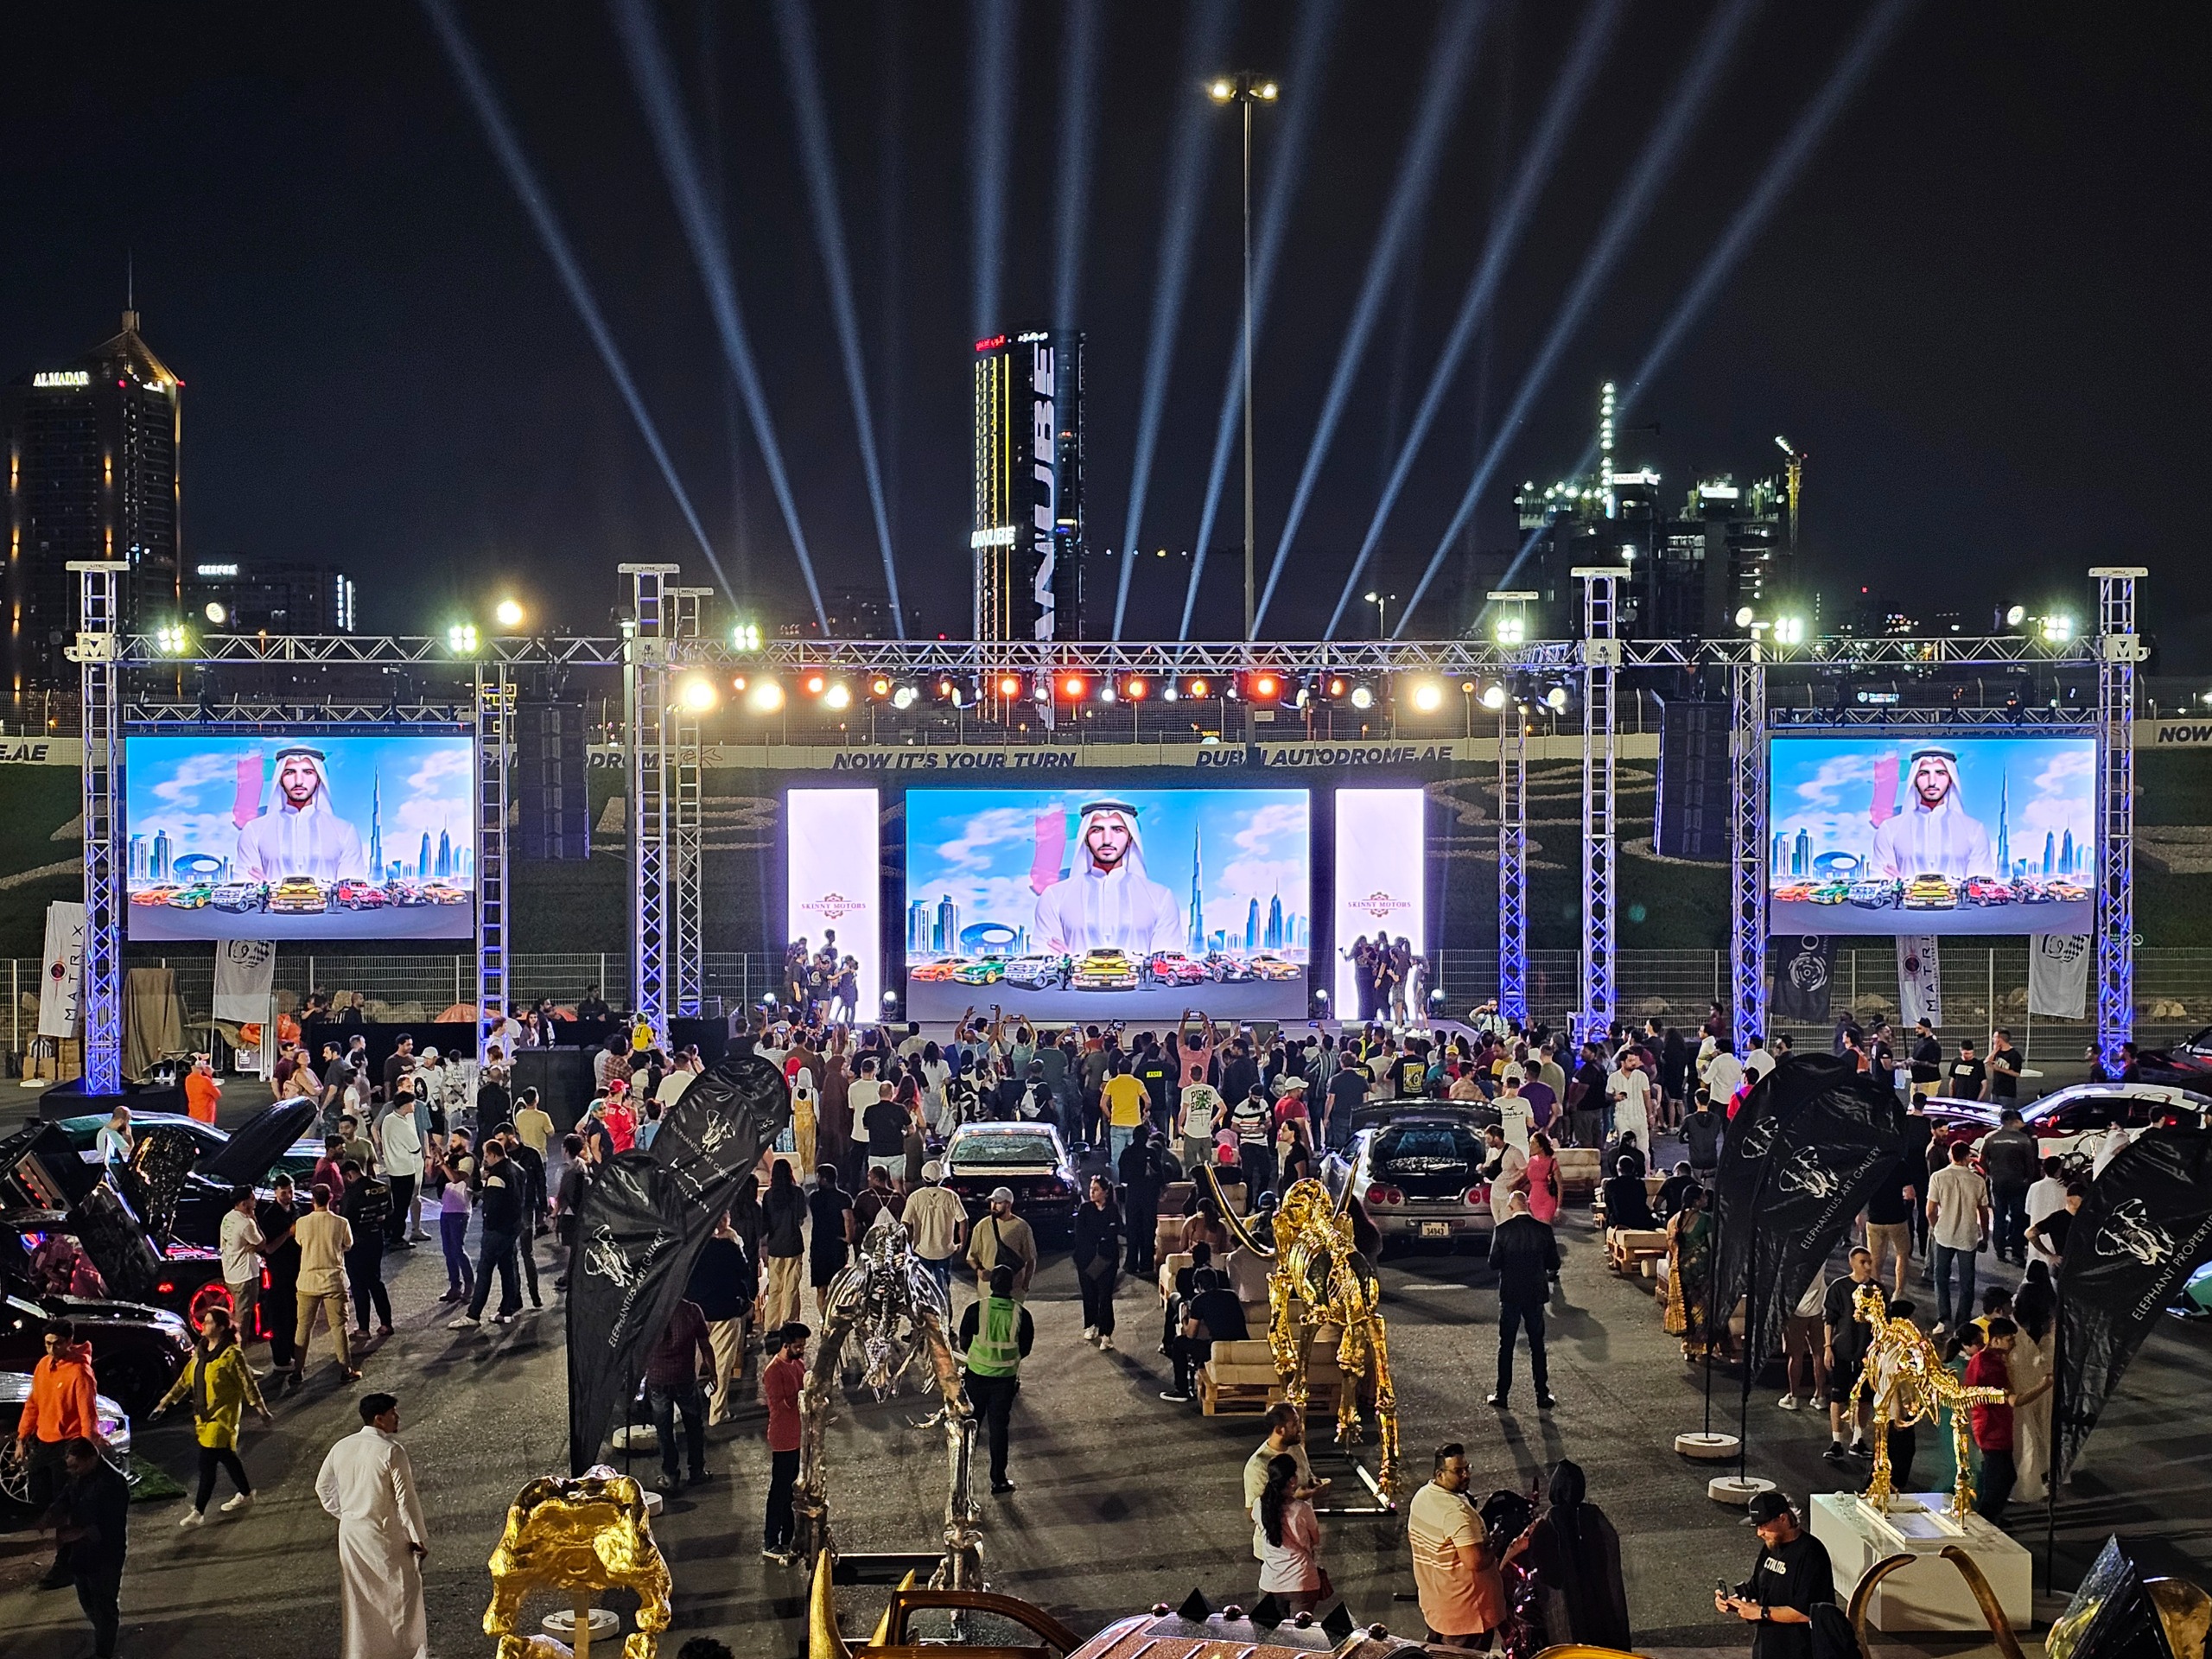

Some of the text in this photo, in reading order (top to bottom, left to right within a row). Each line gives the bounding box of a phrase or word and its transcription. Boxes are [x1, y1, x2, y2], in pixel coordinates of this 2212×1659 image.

[971, 525, 1016, 549] DANUBE
[2158, 726, 2212, 742] NOW
[831, 753, 1077, 769] NOW IT'S YOUR TURN
[1196, 747, 1453, 766] DUBI AUTODROME.AE
[65, 924, 85, 1021] MATRIX
[702, 1154, 714, 1165] ART
[1801, 1146, 1883, 1250] ELEPHANTUS ART GALLERY
[2132, 1267, 2177, 1321] ELEPHANT
[608, 1287, 638, 1348] ELEPHANTUS
[635, 1265, 649, 1287] ART
